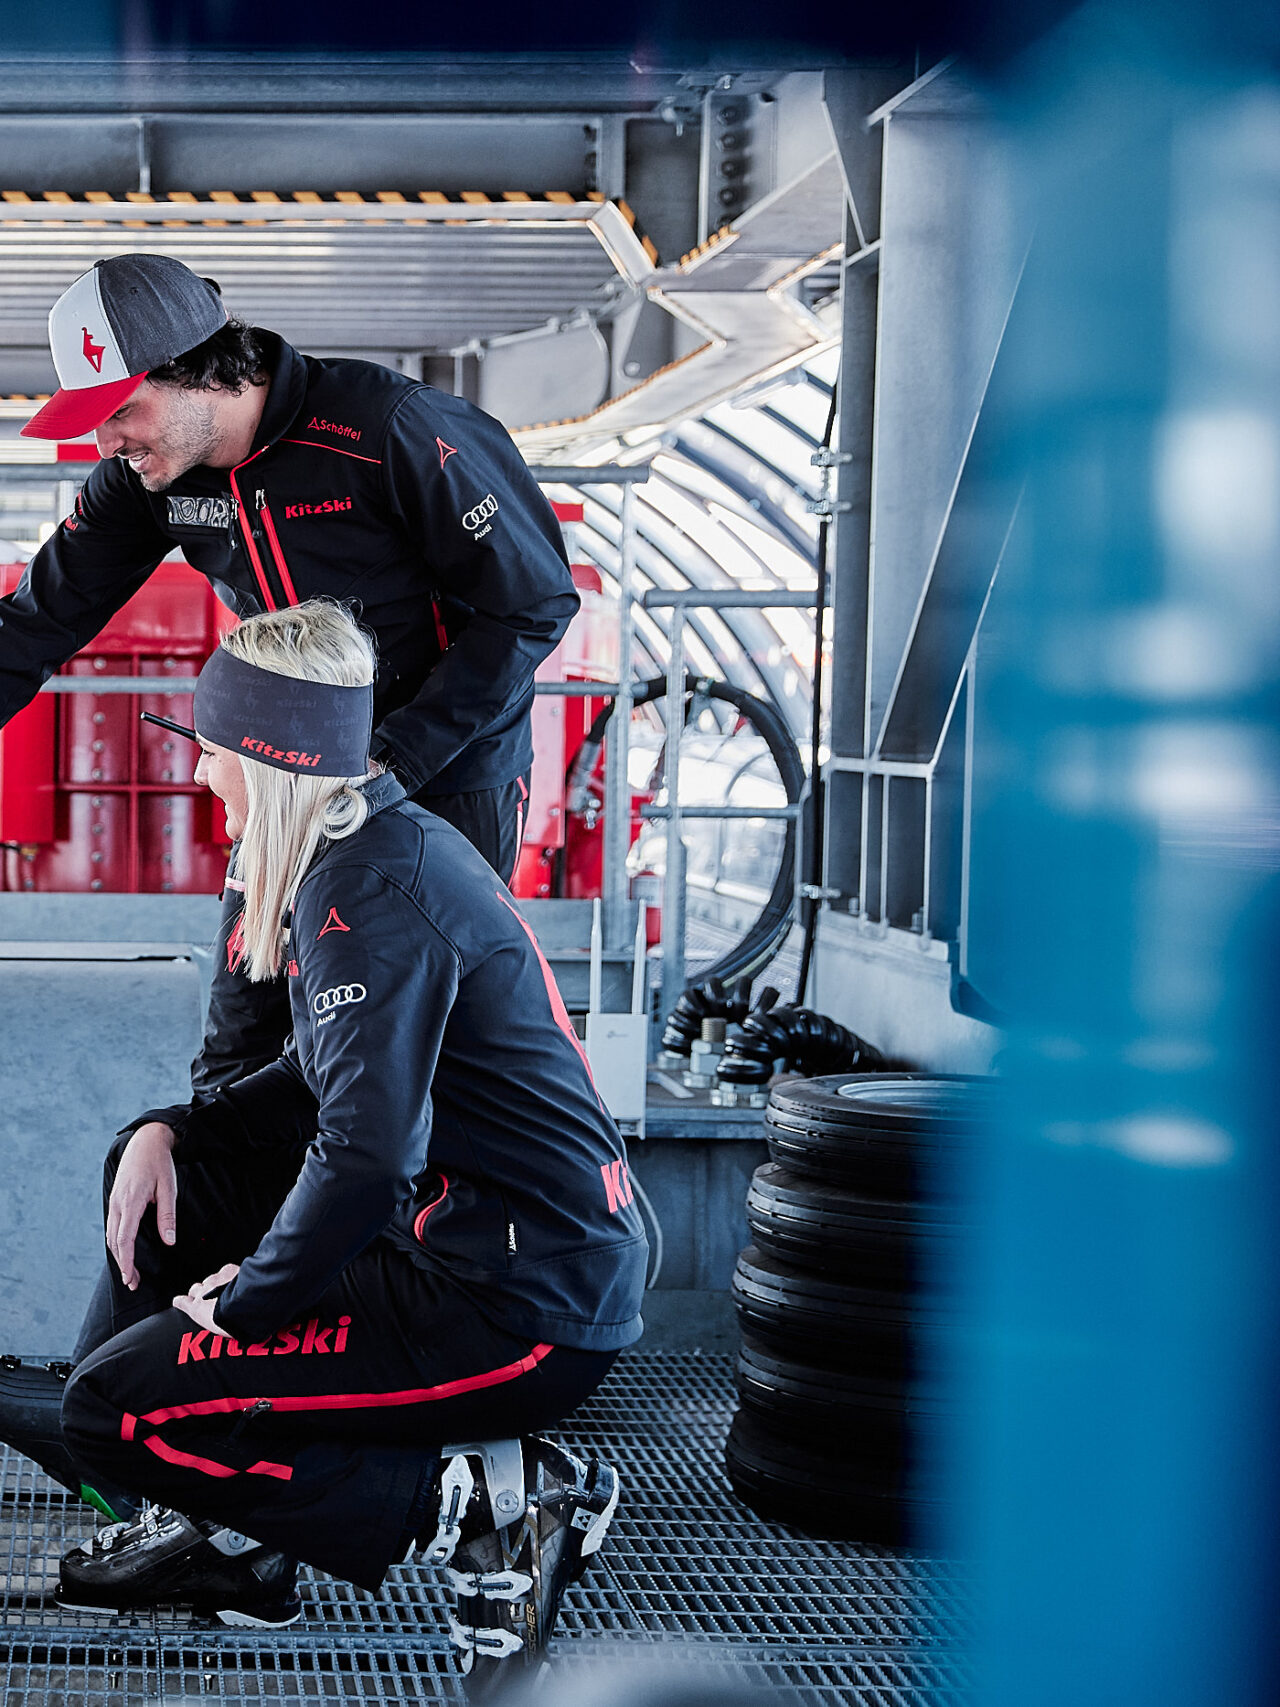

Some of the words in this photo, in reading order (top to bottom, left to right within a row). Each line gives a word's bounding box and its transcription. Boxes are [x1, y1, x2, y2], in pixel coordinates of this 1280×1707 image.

[320, 419, 362, 441] Schöffel
[285, 496, 352, 519] KitzSki
[474, 523, 493, 541] Audi
[241, 736, 322, 767] KitzSki
[317, 1011, 336, 1027] Audi
[526, 1603, 536, 1665] ISCHER
